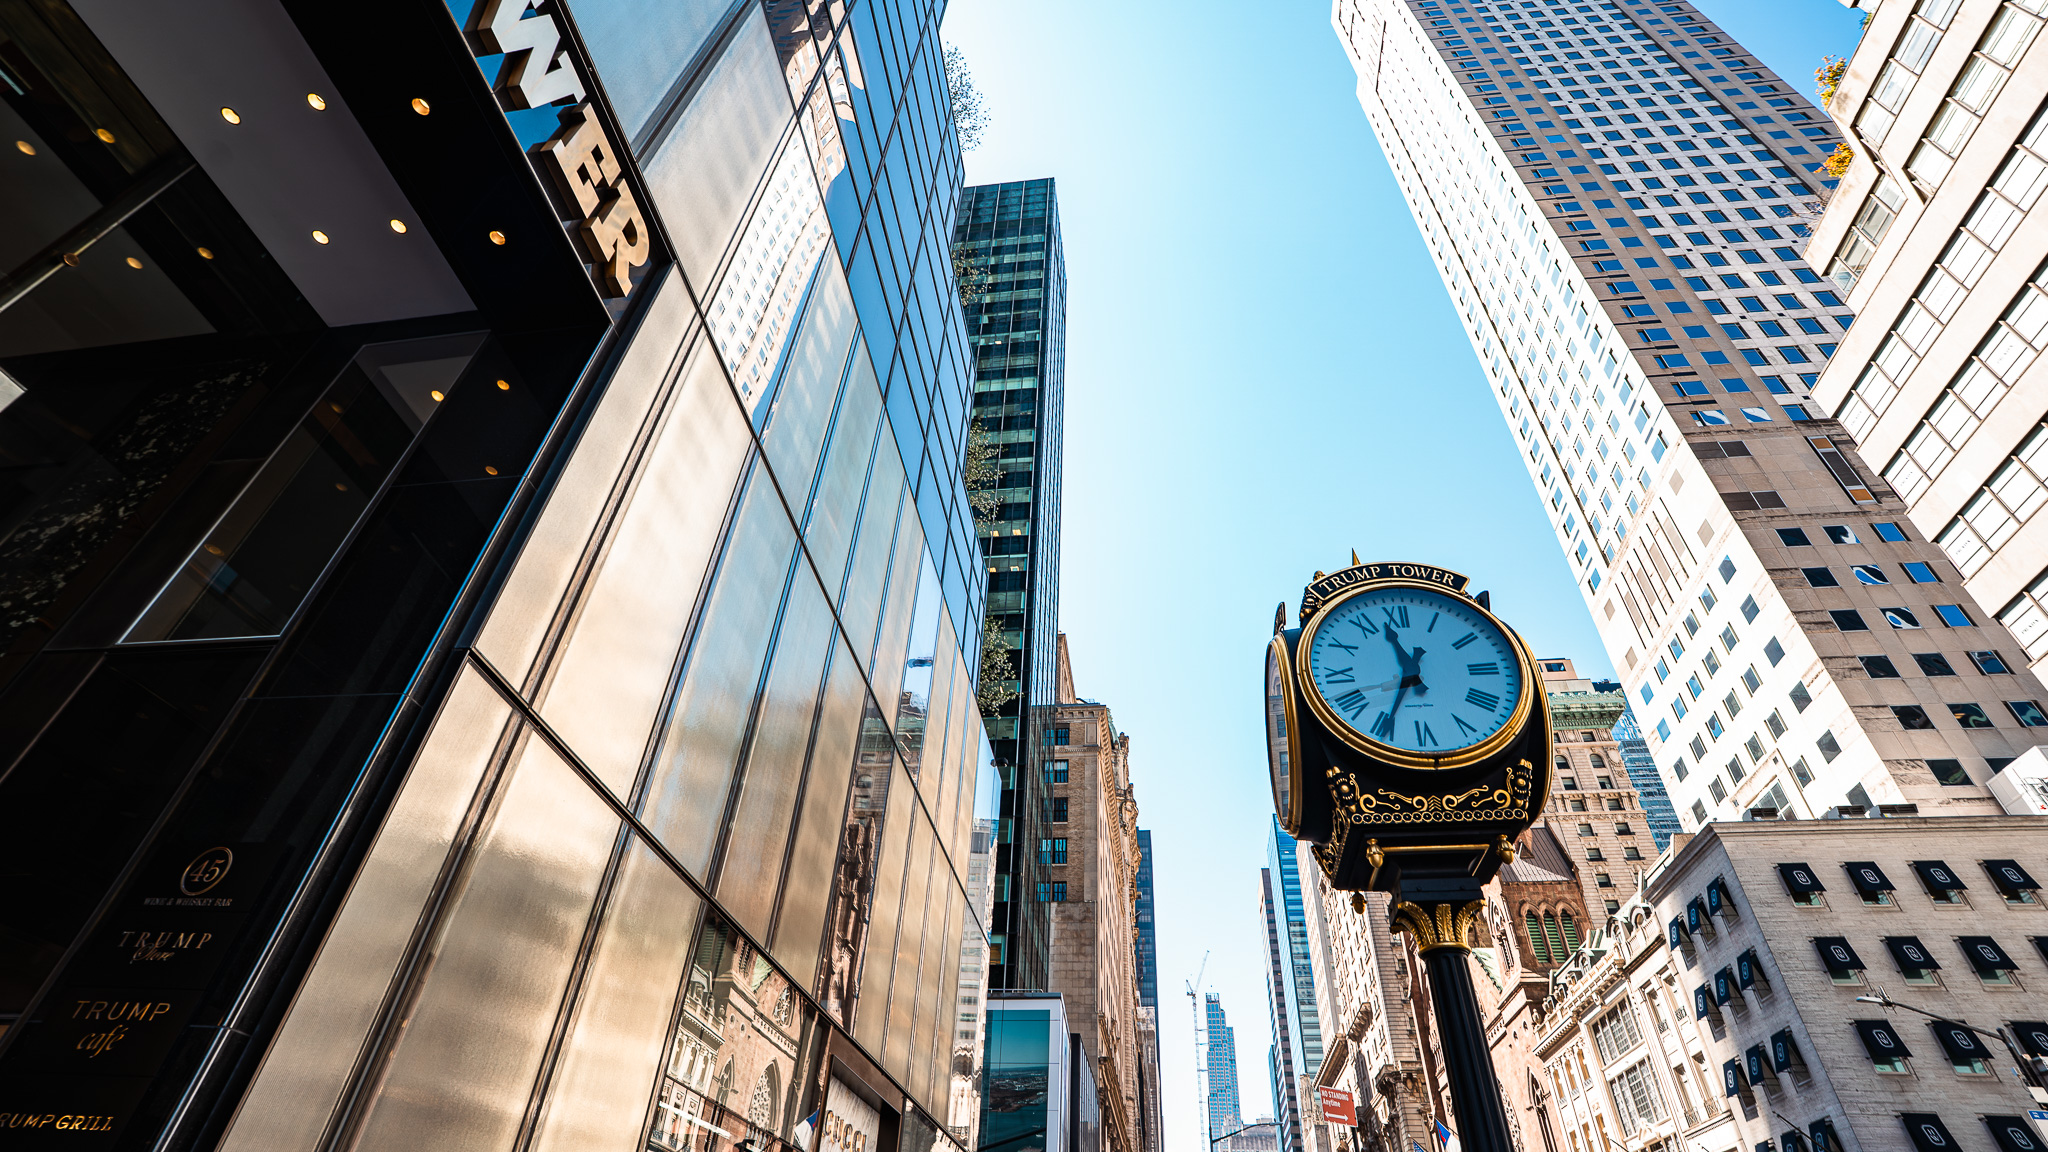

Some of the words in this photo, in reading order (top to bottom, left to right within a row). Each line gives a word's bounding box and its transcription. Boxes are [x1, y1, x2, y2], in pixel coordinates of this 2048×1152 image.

[1318, 565, 1381, 593] TRUMP
[1388, 564, 1455, 586] TOWER
[1348, 612, 1380, 639] XI
[1381, 605, 1410, 628] XII
[1327, 636, 1359, 657] X
[1323, 666, 1355, 684] IX
[1466, 662, 1500, 675] III
[1414, 720, 1439, 747] VI
[1450, 712, 1478, 738] V
[189, 859, 226, 882] 45
[144, 897, 167, 906] WINE
[176, 897, 214, 906] WHISKEY
[214, 898, 233, 906] BAR
[117, 930, 213, 950] TRUMP
[129, 942, 176, 964] Store
[72, 1000, 171, 1022] TRUMP
[76, 1023, 129, 1058] café
[1321, 1090, 1328, 1098] NO
[1328, 1091, 1349, 1102] STANDING
[1322, 1098, 1341, 1107] Anytime
[55, 1114, 114, 1131] GRILL
